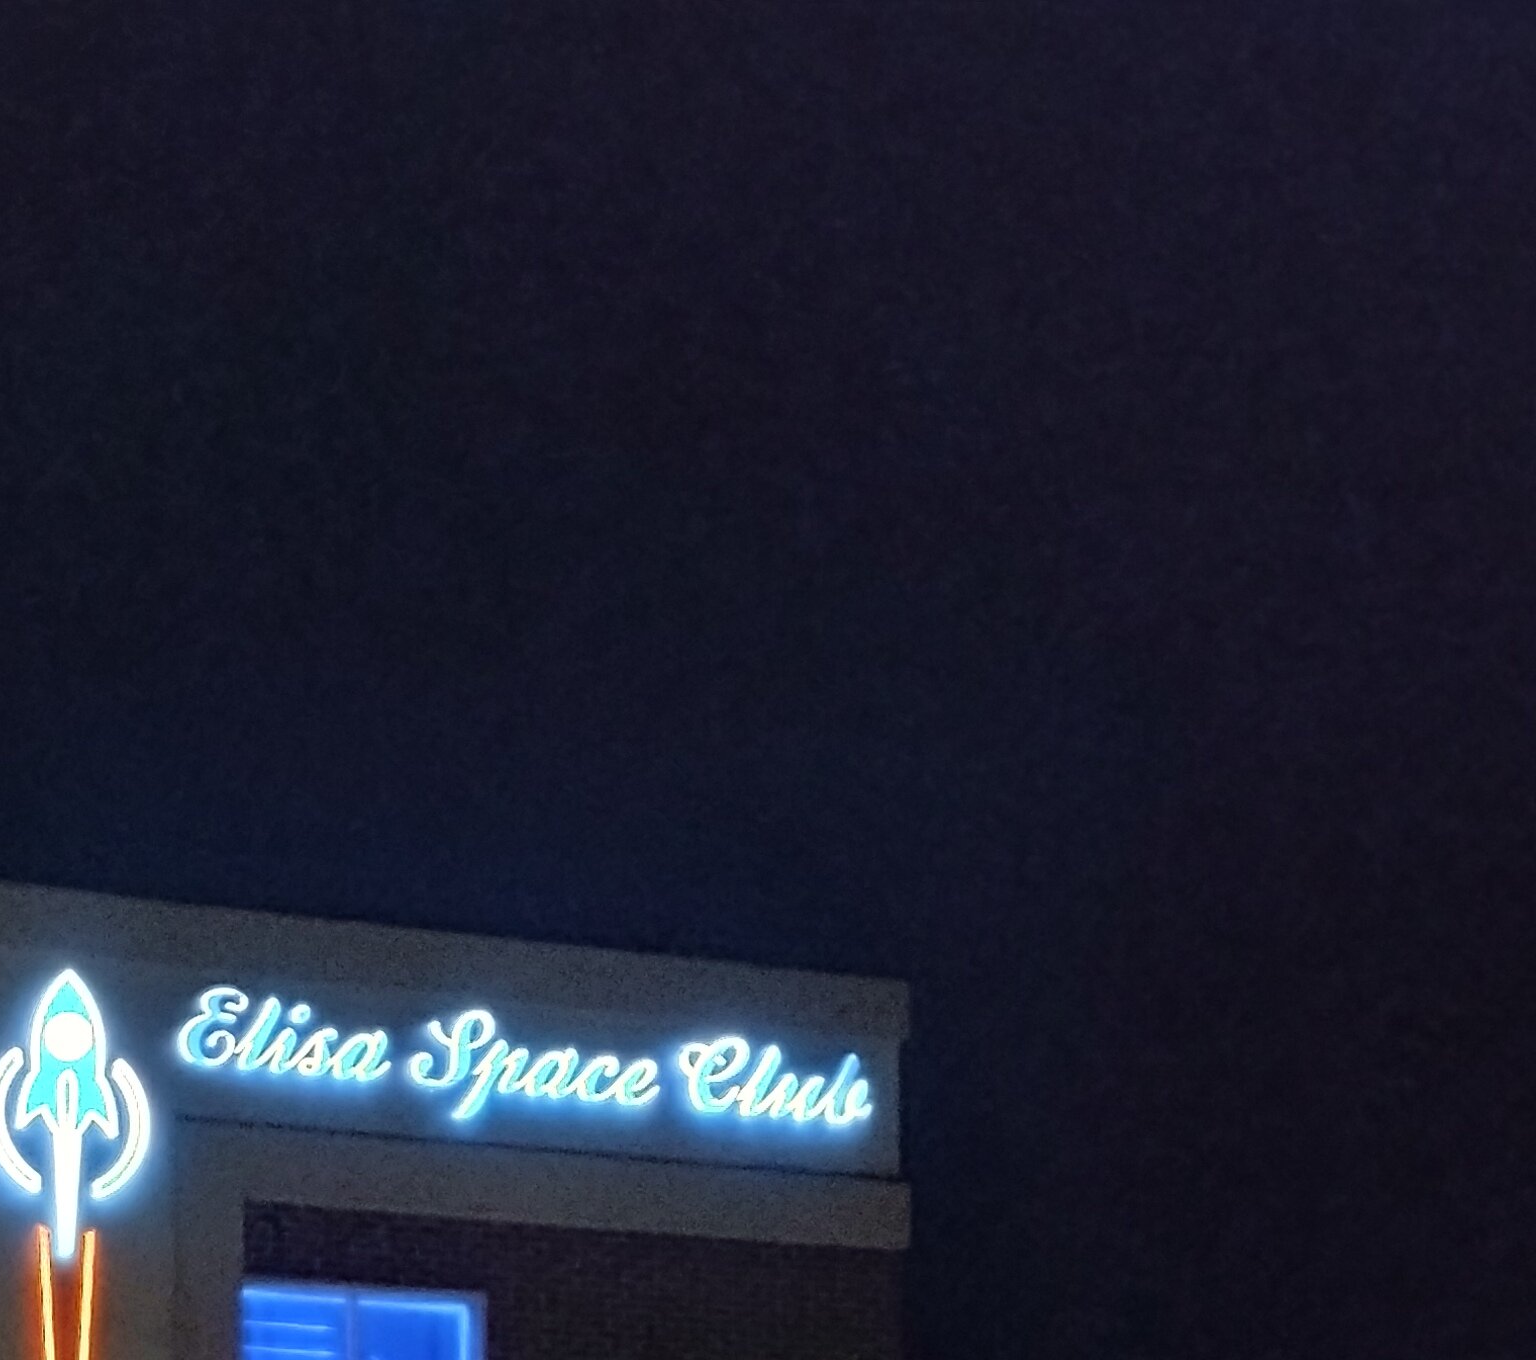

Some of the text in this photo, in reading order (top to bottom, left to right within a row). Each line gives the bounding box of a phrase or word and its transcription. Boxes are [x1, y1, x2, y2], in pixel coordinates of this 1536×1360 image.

[177, 986, 872, 1125] Elisa Space Club
